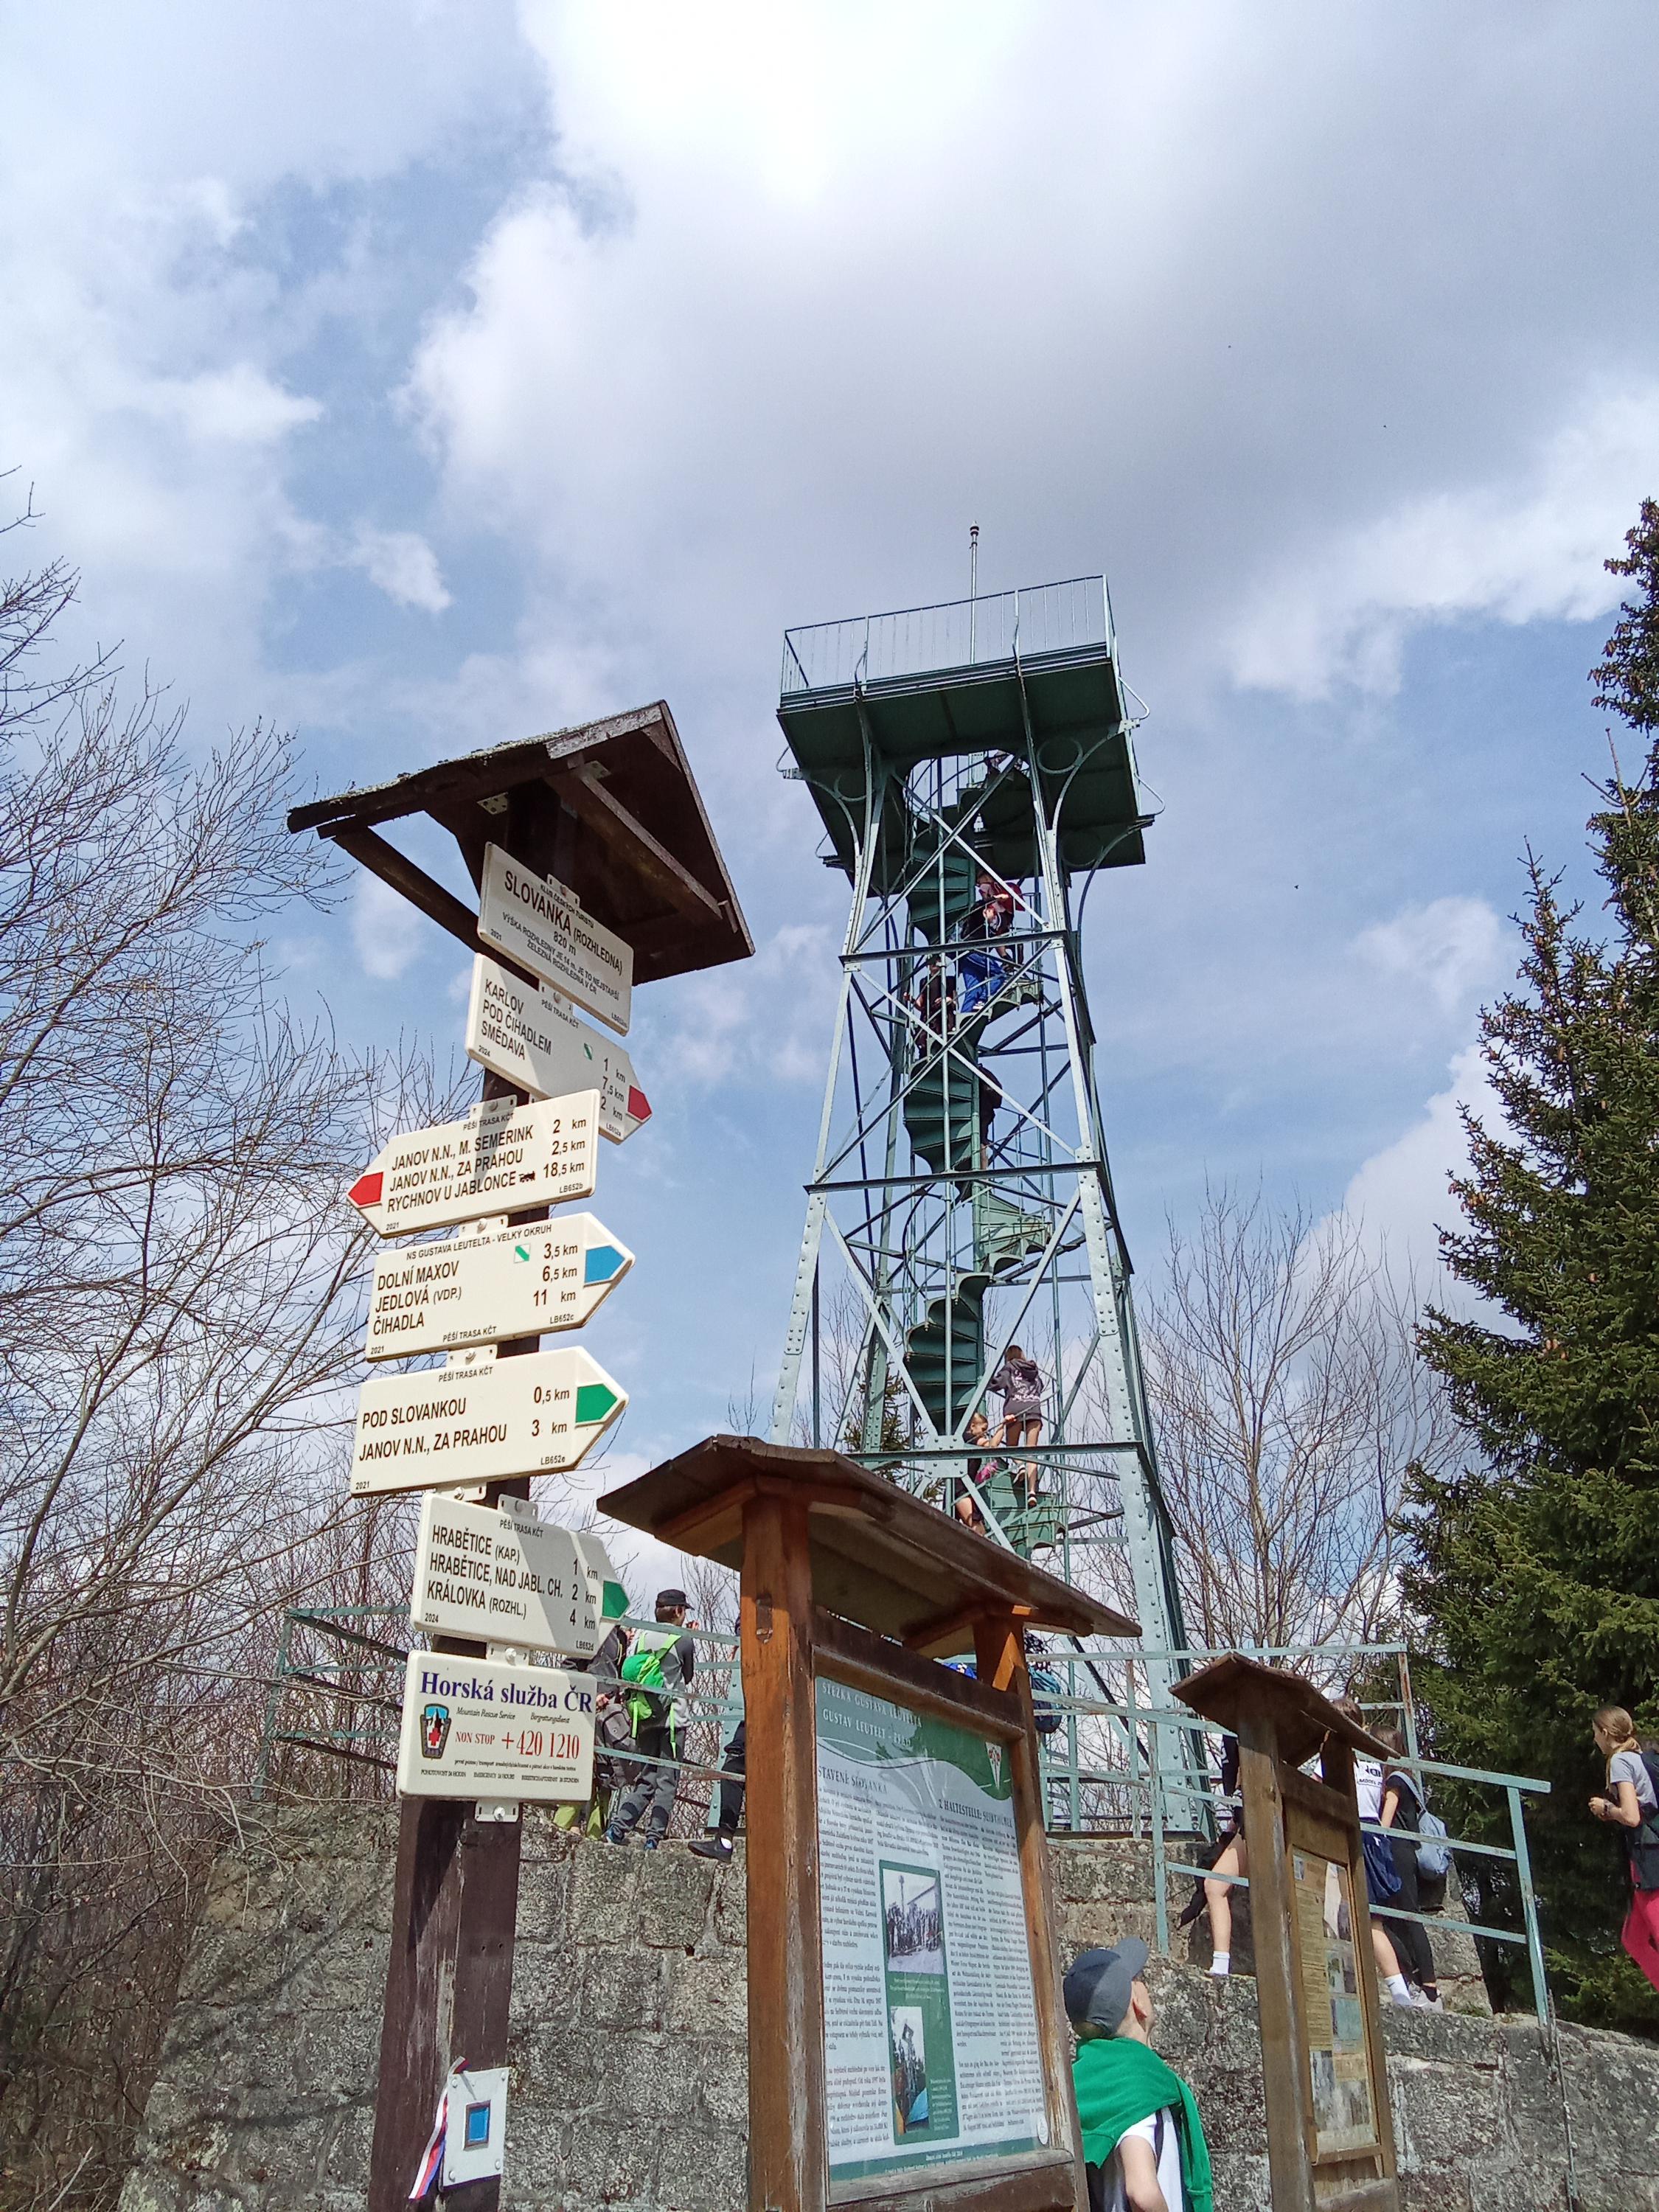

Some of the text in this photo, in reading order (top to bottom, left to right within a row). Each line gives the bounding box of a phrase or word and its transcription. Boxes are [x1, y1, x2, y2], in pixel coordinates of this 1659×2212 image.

[540, 884, 553, 898] KLUB
[504, 870, 623, 976] SLOVANKA (ROZHLEDNA)
[490, 928, 502, 941] 2021
[554, 931, 576, 956] 820 m
[503, 912, 522, 933] VÝŠKA
[523, 927, 556, 955] ROZHLEDNY
[556, 950, 563, 960] JE
[564, 956, 570, 966] 14
[578, 966, 585, 975] JE
[585, 970, 592, 981] TO
[593, 975, 620, 1001] NEJSTARŠÍ
[526, 939, 552, 964] ŽELEZNÁ
[553, 959, 585, 984] ROZHLEDNA
[589, 984, 597, 995] ČR
[484, 978, 524, 1015] KARLOV
[541, 998, 580, 1029] PĚŠÍ TRASA KČT
[482, 999, 552, 1055] POD ČIHADLEM
[481, 1020, 526, 1060] SMĚDAVA
[479, 1045, 490, 1057] 2024
[604, 1057, 626, 1083] 1 km
[602, 1076, 625, 1103] 7,5 km
[463, 1112, 515, 1131] PĚŠÍ TRASA KČT
[613, 1107, 623, 1121] km
[553, 1118, 587, 1135] 2 km
[392, 1124, 534, 1171] JANOV N.N., M. SEMERINK
[552, 1139, 586, 1157] 2,5 km
[389, 1148, 524, 1192] JANOV N.N., ZA PRAHOU
[543, 1161, 585, 1180] 18,5 km
[387, 1170, 517, 1214] RYCHNOV U JABLONCE
[559, 1183, 583, 1194] LB652b
[386, 1221, 400, 1231] 2021
[406, 1251, 417, 1261] NS
[418, 1245, 453, 1259] GUSTAVA
[453, 1237, 491, 1252] LEUTELTA
[497, 1230, 522, 1244] VELKÝ
[523, 1224, 552, 1238] OKRUH
[544, 1243, 578, 1260] 3,5 km
[378, 1260, 460, 1290] DOLNÍ MAXOV
[542, 1266, 577, 1283] 6,5 km
[375, 1286, 462, 1313] JEDLOVÁ (VDP.)
[533, 1290, 576, 1307] 11 km
[373, 1311, 425, 1336] ČIHADLA
[549, 1313, 574, 1324] LB652c
[443, 1325, 497, 1343] PĚŠÍ TRASA KČT
[371, 1345, 384, 1355] 2021
[439, 1366, 493, 1382] PĚŠÍ TRASA KČT
[534, 1385, 570, 1405] 0,5 km
[362, 1397, 467, 1430] POD SLOVANKOU
[531, 1419, 568, 1436] 3 km
[359, 1424, 507, 1462] JANOV N.N., ZA PRAHOU
[540, 1455, 566, 1466] LB652e
[355, 1481, 370, 1490] 2021
[500, 1520, 544, 1538] PĚŠÍ TRASA KČT
[433, 1524, 521, 1565] HRABĚTICE (KAP.)
[430, 1552, 563, 1599] HRABĚTICE, NAD JABL. CH.
[573, 1558, 598, 1580] 1 km
[427, 1578, 526, 1619] KRÁLOVKA (ROZHL.)
[571, 1583, 597, 1604] 2 km
[425, 1613, 439, 1624] 2024
[569, 1609, 596, 1630] 4 km
[420, 1671, 592, 1713] Horská služba ČR
[822, 1682, 851, 1702] STEZKA
[855, 1694, 886, 1716] GUSTAVA
[456, 1707, 480, 1717] Mountain
[481, 1709, 498, 1718] Rescue
[498, 1711, 516, 1720] Service
[823, 1708, 852, 1728] GUSTAV
[455, 1731, 580, 1760] NON STOP +420 1210
